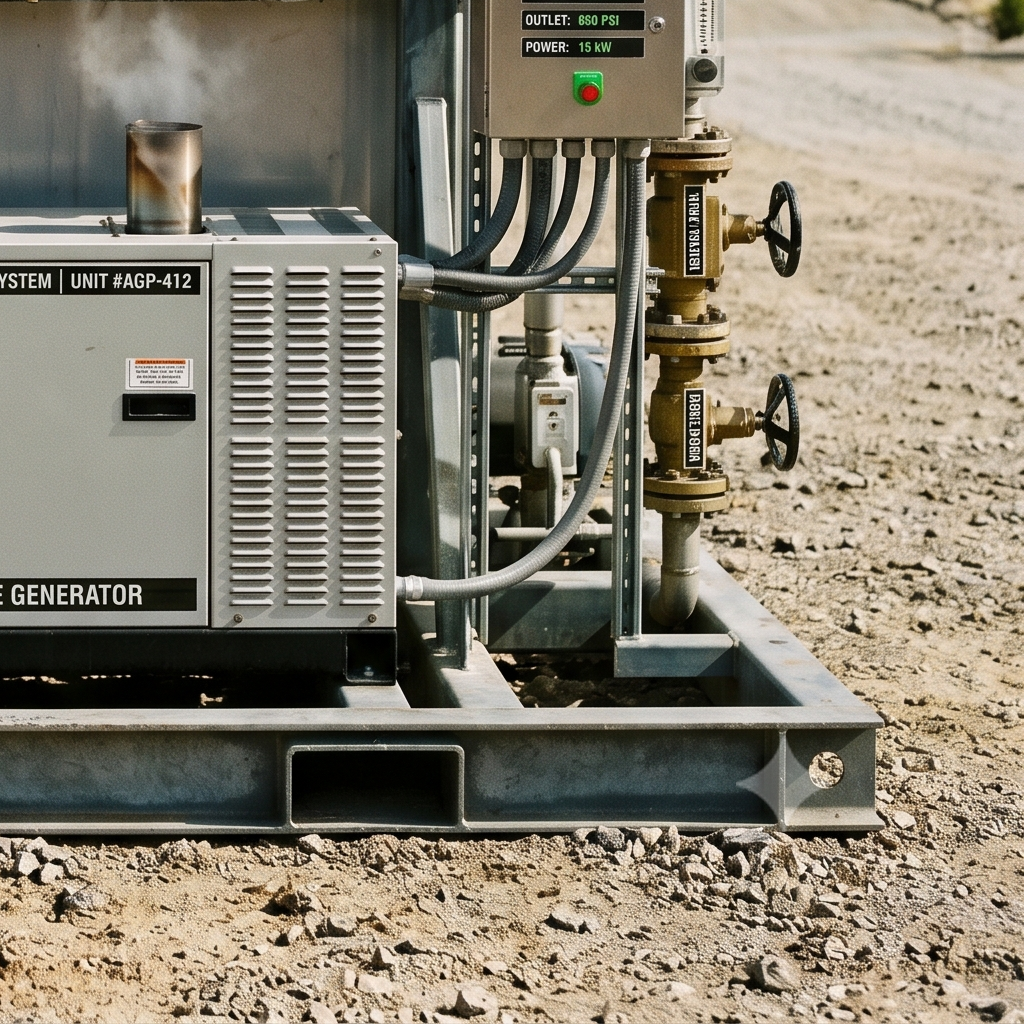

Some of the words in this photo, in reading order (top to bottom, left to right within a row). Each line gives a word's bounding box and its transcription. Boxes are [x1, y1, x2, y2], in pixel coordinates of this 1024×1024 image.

[525, 14, 571, 27] OUTLET:
[601, 14, 620, 27] PSI
[525, 41, 569, 54] POWER:
[578, 41, 592, 54] 15
[594, 41, 612, 54] kW
[71, 272, 109, 291] UNIT
[112, 272, 193, 291] #AGP-412
[10, 582, 144, 606] GENERATOR
